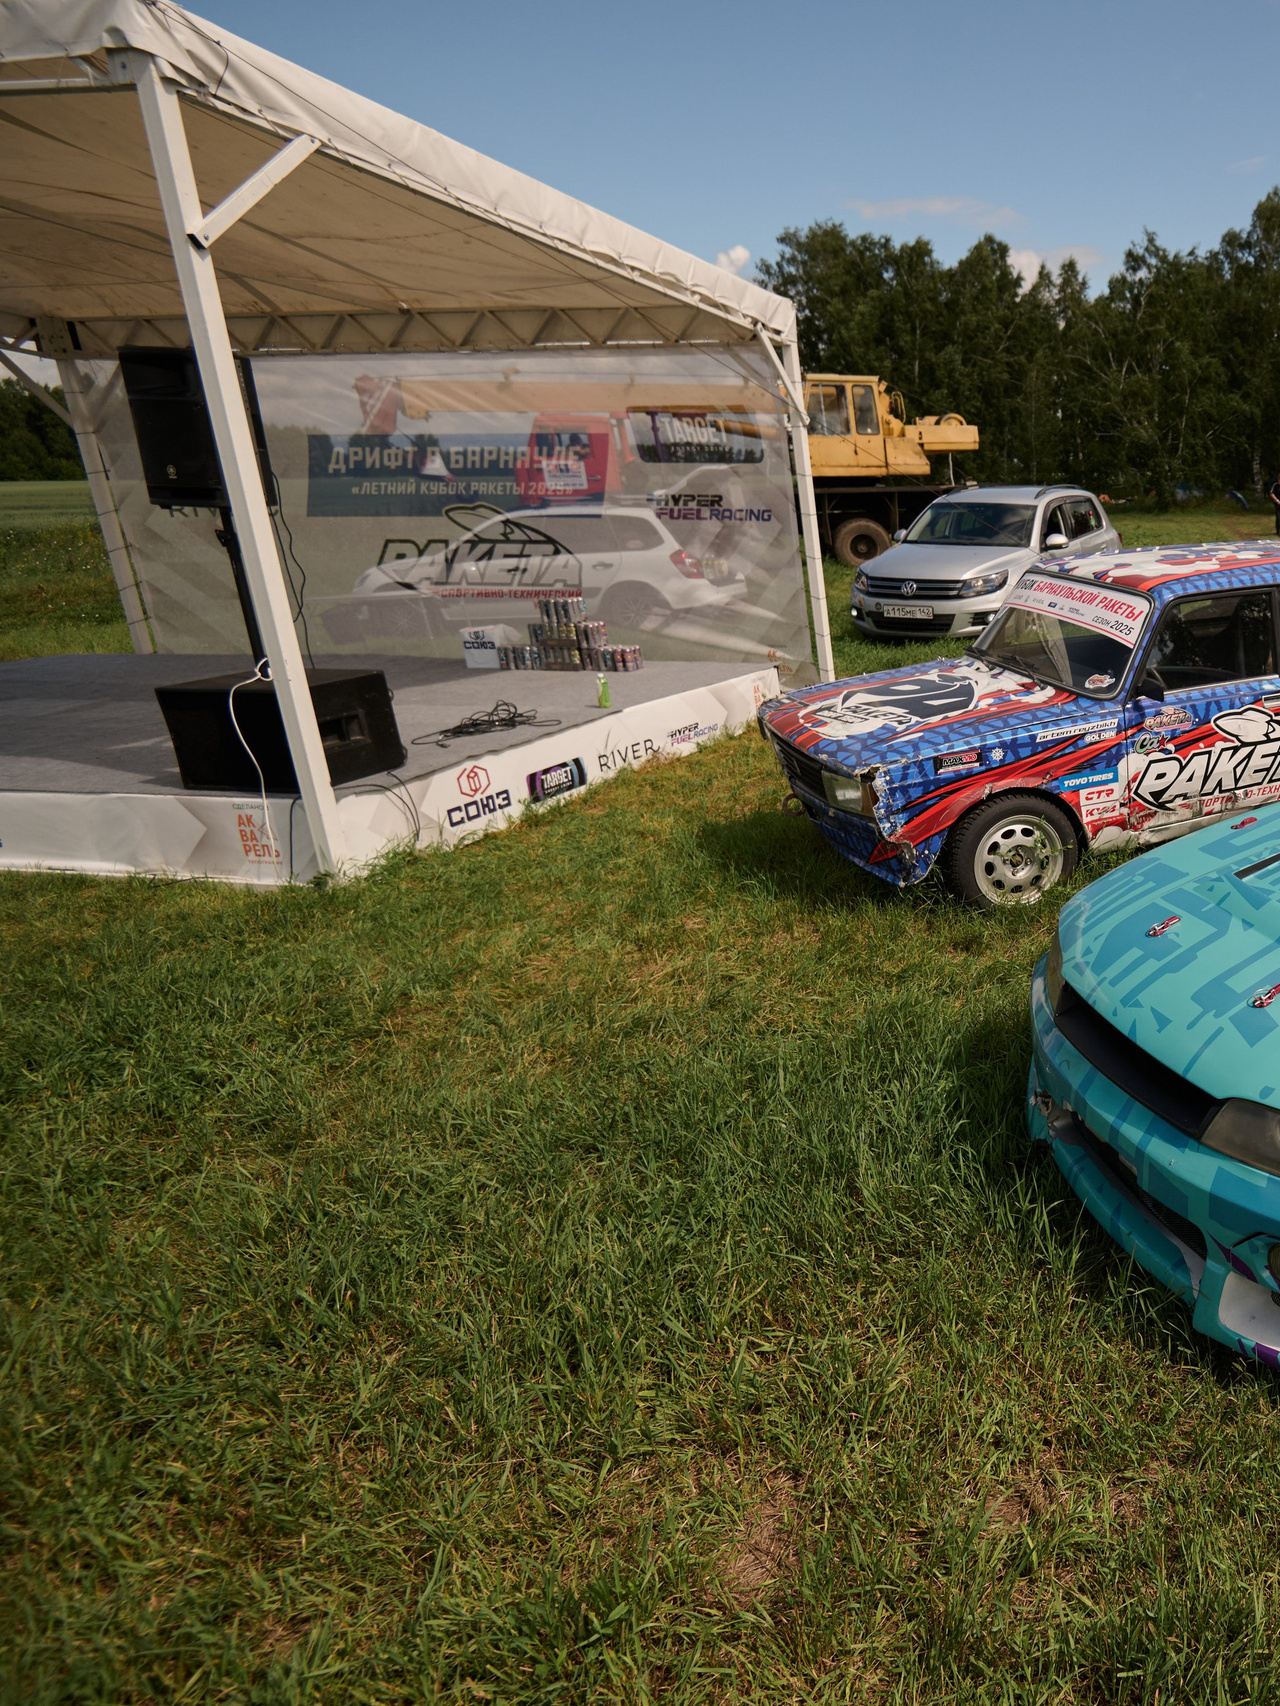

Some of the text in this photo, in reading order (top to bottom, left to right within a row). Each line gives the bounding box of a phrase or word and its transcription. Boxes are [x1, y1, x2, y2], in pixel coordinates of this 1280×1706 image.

[660, 417, 728, 443] TARGET
[328, 446, 418, 474] ДРИФТ
[351, 479, 416, 496] «ЛЕТНИЙ
[420, 481, 466, 496] КУБОК
[470, 481, 525, 496] РАКЕТЫ
[655, 494, 723, 508] HYPER
[1032, 580, 1101, 606] БАРНАУЛЬСКОЙ
[1096, 596, 1145, 622] РАКЕТЫ
[885, 607, 931, 618] А115МЕ 142
[1091, 615, 1135, 636] СЕЗОН 2025
[463, 640, 497, 650] СОЮЗ
[670, 722, 700, 739] HYPER
[1038, 729, 1073, 741] artem
[598, 738, 661, 772] RIVER
[540, 766, 573, 790] TARGET
[1063, 772, 1115, 788] TOYO TIRES
[1085, 788, 1115, 801] CTR
[447, 789, 512, 828] СОЮЗ
[237, 813, 256, 828] АК
[239, 829, 260, 843] ВА
[243, 843, 281, 858] РЕЛЬ
